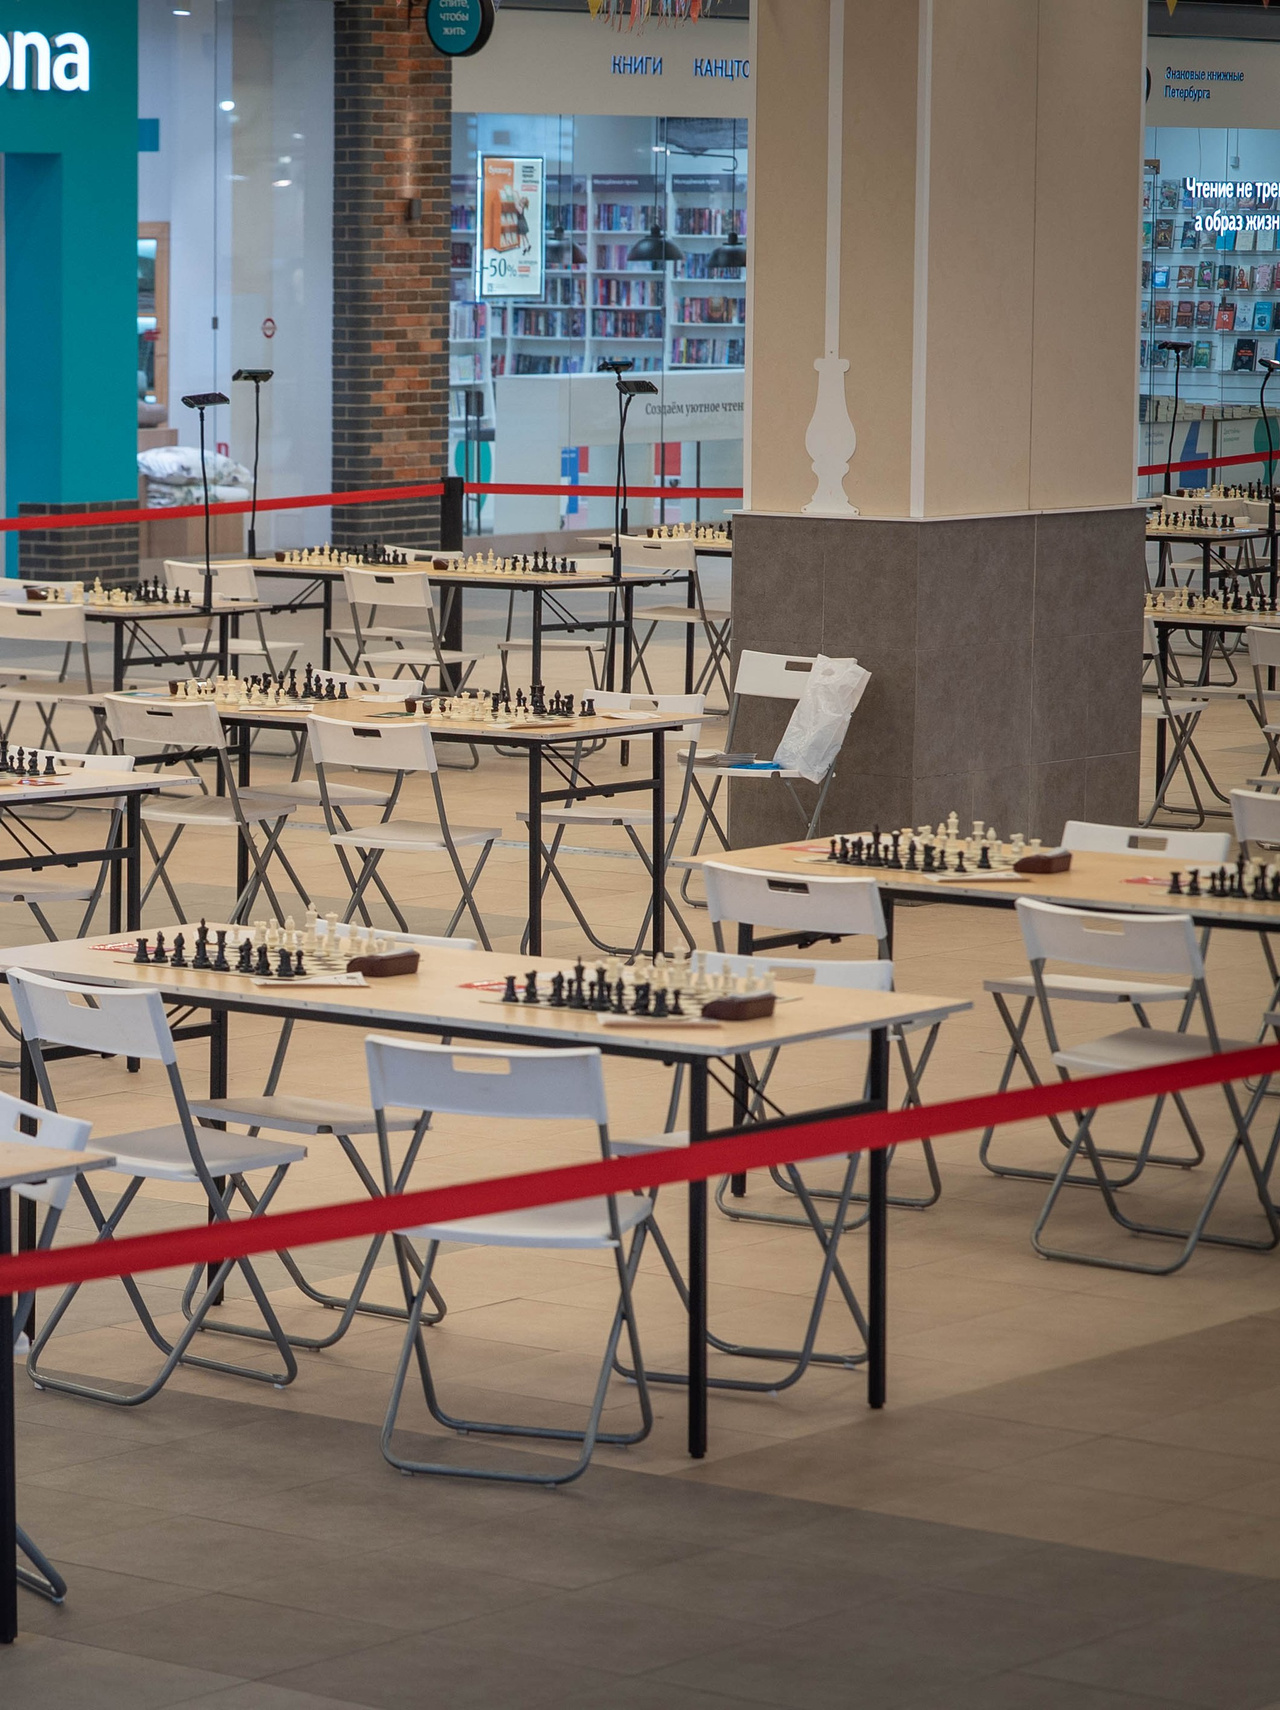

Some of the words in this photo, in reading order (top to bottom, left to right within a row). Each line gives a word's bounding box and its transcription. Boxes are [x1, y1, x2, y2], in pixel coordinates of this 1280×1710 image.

[439, 11, 470, 22] чтобы
[442, 26, 467, 36] жить
[611, 55, 663, 75] КНИГИ
[693, 58, 750, 81] КАНЦТО
[1165, 66, 1206, 80] Знаковые
[1206, 71, 1245, 82] книжные
[1164, 85, 1211, 102] Петербурга
[1186, 177, 1234, 198] Чтение
[1236, 182, 1253, 198] не
[1255, 182, 1280, 204] тре
[1194, 215, 1204, 231] а
[1205, 209, 1243, 237] образ
[1245, 214, 1280, 231] жизн
[483, 257, 518, 278] -50%
[645, 402, 684, 416] Создаём
[685, 402, 721, 418] уютное
